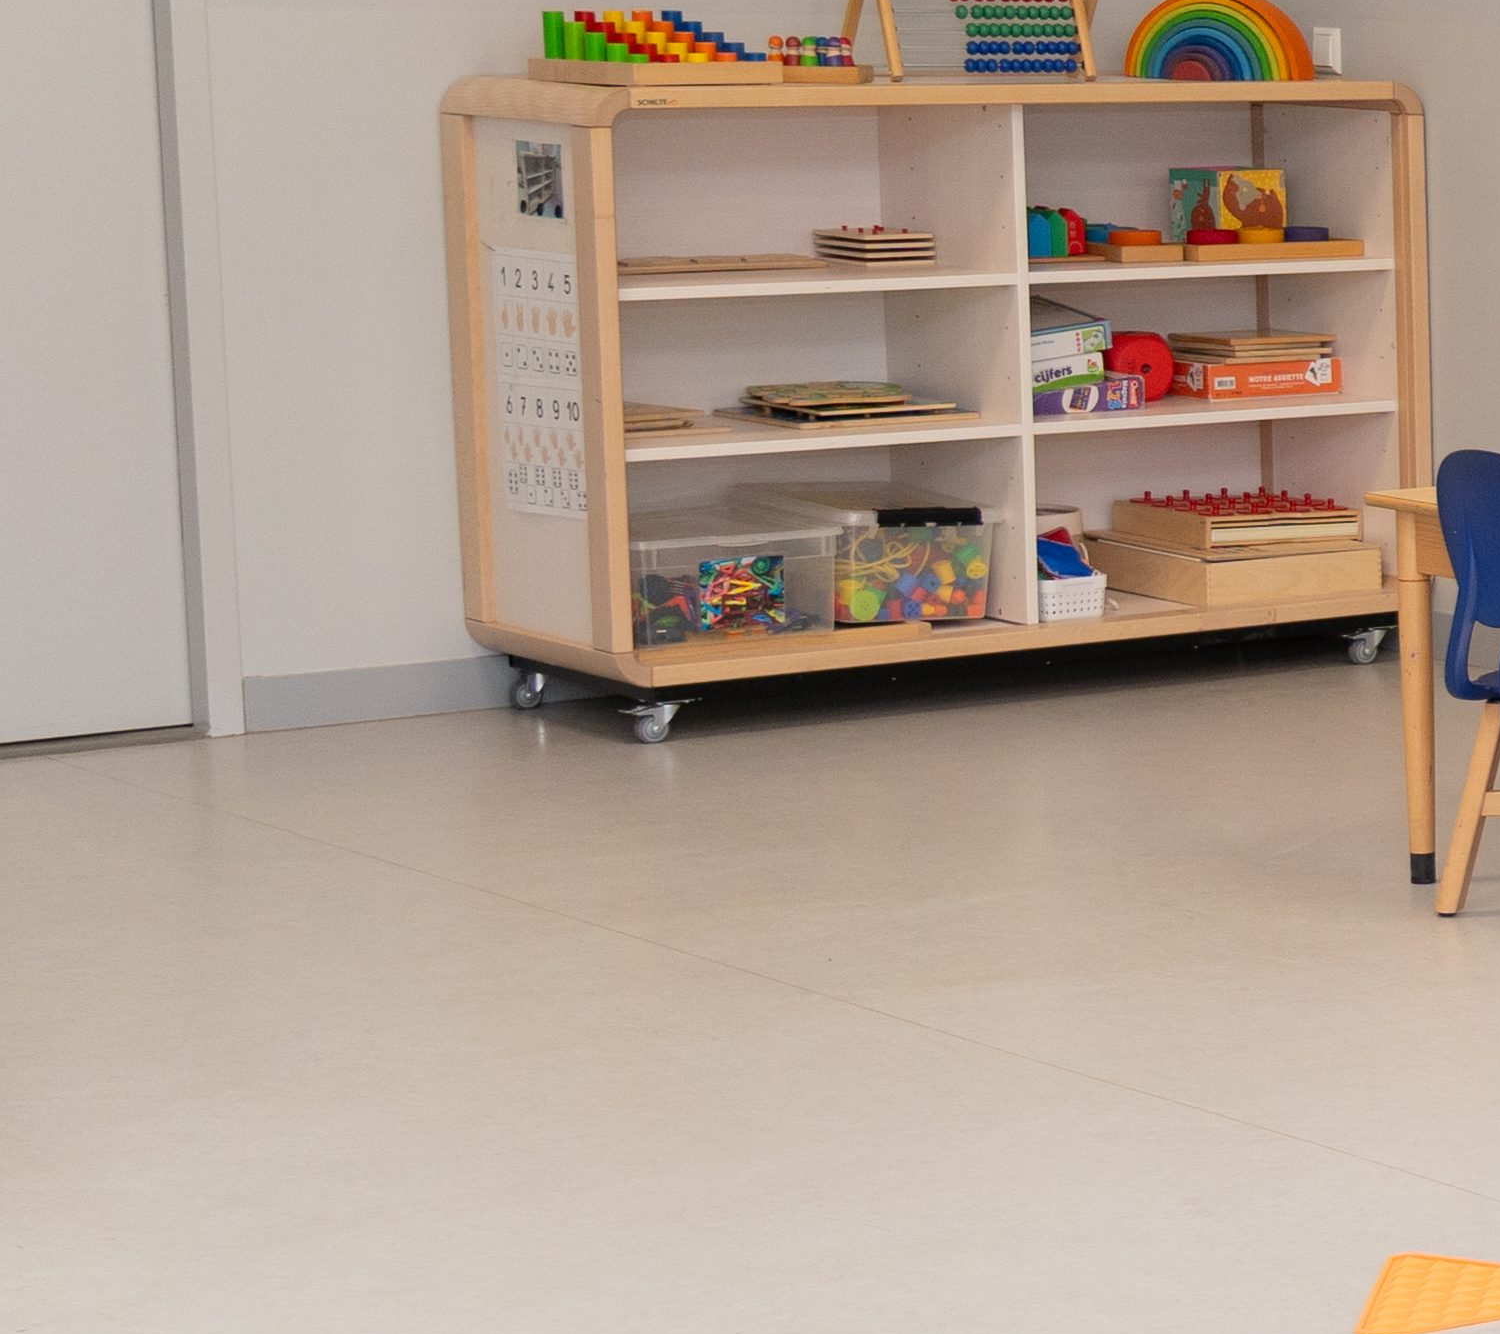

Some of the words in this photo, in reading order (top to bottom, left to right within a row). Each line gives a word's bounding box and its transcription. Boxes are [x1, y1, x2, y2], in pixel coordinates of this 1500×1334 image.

[501, 267, 506, 287] 1
[515, 268, 522, 288] 2
[532, 270, 539, 291] 3
[548, 273, 554, 292] 4
[564, 274, 571, 295] 5
[1034, 366, 1073, 383] cijfers
[507, 395, 513, 414] 6
[520, 396, 526, 416] 7
[536, 398, 543, 418] 8
[553, 400, 560, 420] 9
[567, 401, 580, 422] 10
